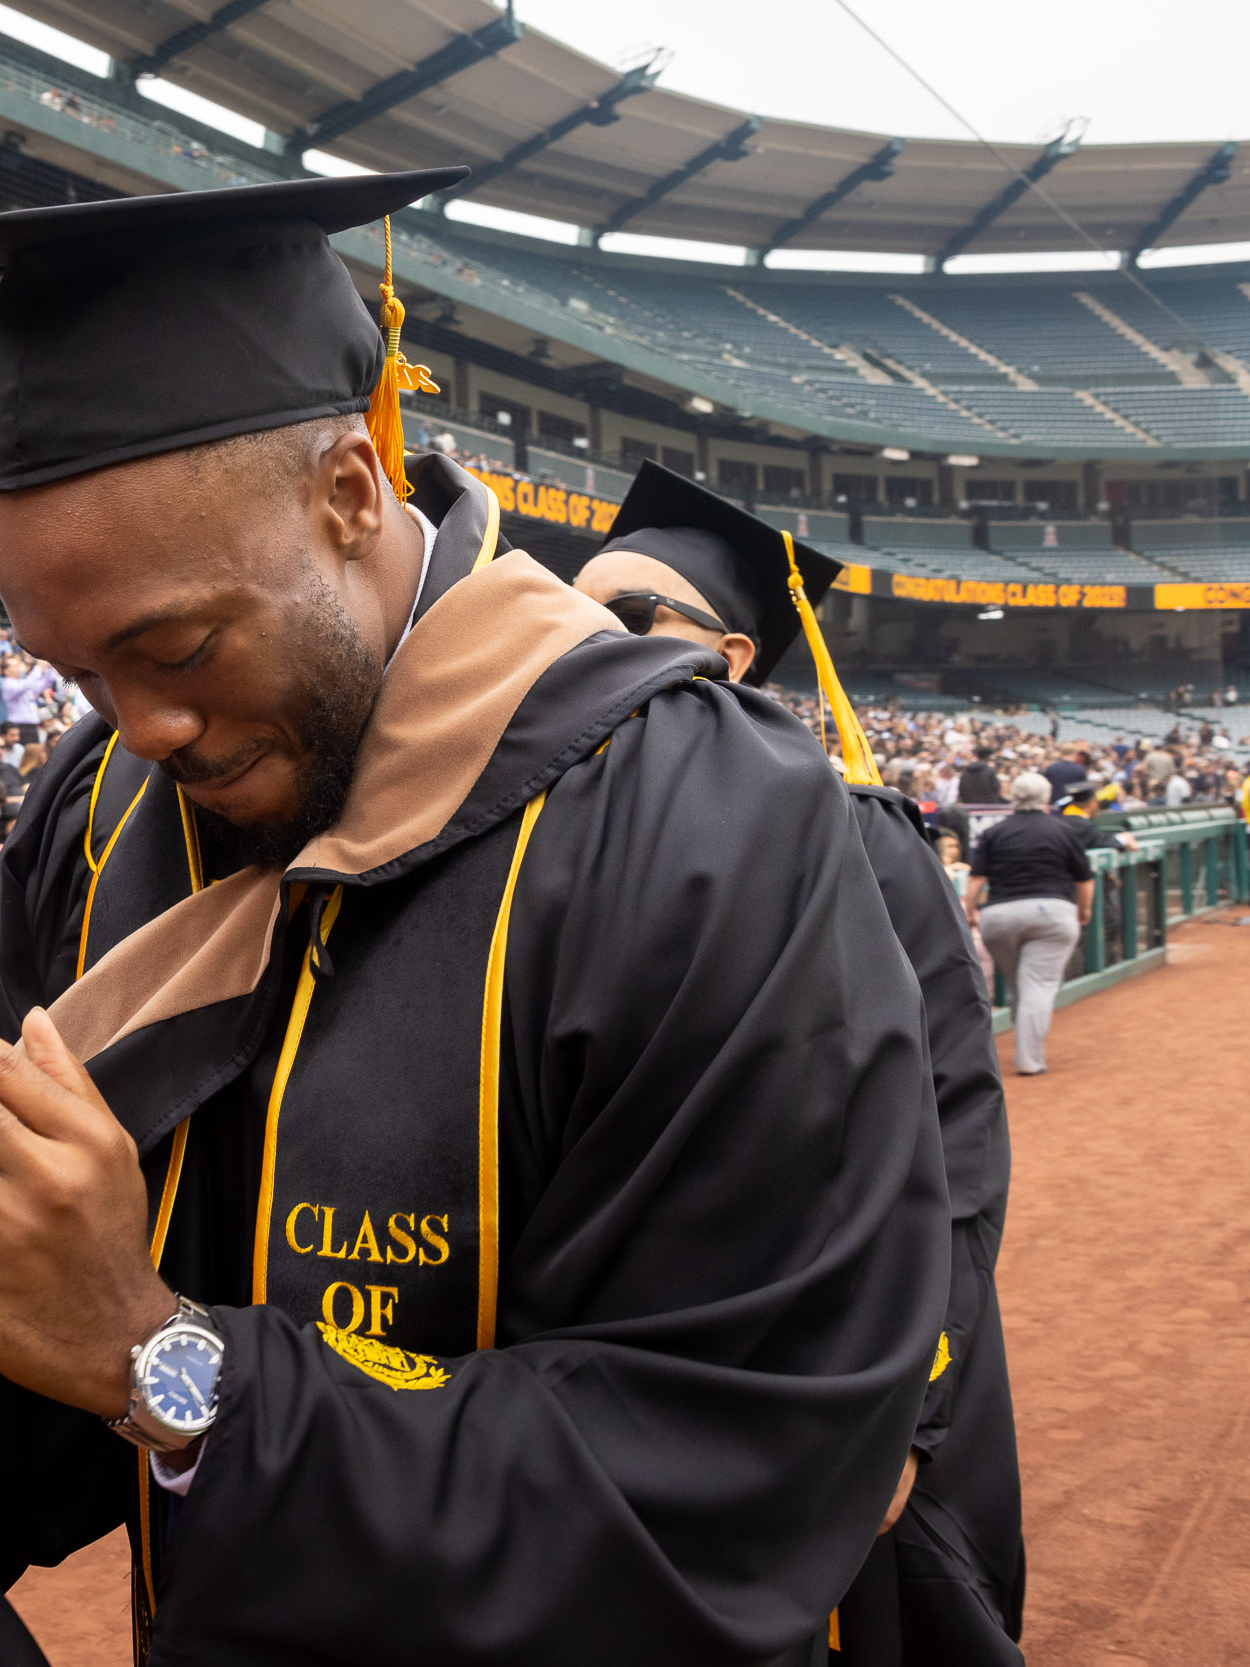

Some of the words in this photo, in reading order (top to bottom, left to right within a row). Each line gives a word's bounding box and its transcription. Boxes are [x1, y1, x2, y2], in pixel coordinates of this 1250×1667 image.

[517, 481, 567, 524] CLASS
[569, 493, 590, 528] OF
[285, 1202, 450, 1266] CLASS
[321, 1281, 399, 1336] OF
